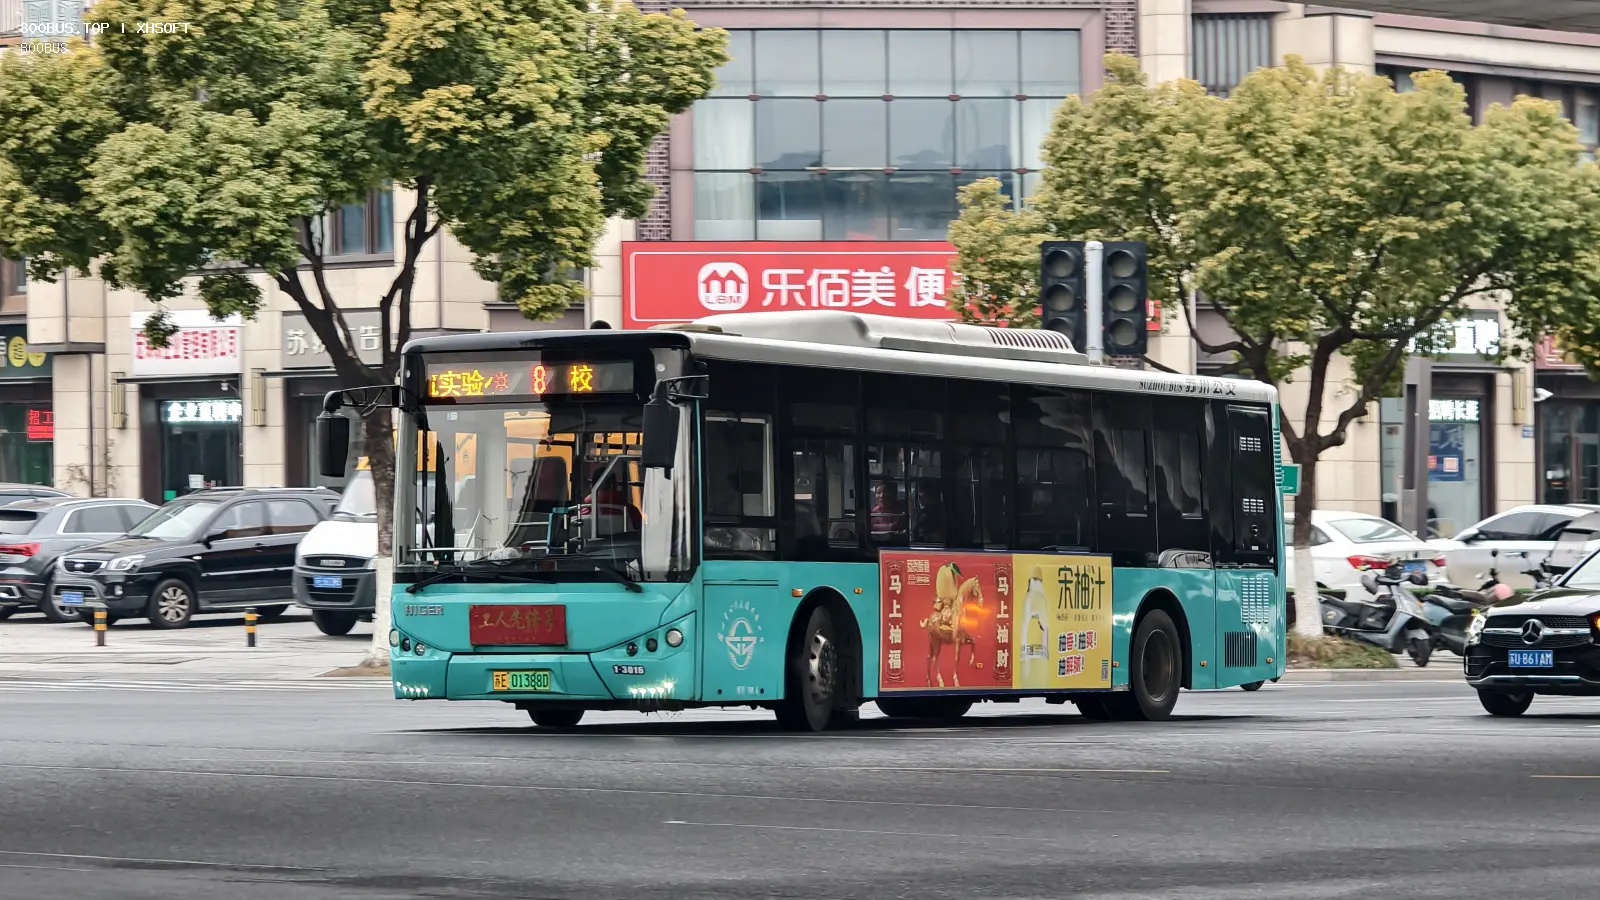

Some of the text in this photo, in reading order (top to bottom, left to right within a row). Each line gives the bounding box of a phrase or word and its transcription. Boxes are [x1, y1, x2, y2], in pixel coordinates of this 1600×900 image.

[761, 265, 897, 308] 乐佰美
[430, 369, 494, 397] 实验
[532, 364, 547, 395] 8
[568, 364, 594, 393] 校
[1058, 564, 1106, 610] 宋柚汁
[404, 604, 445, 617] HIGER
